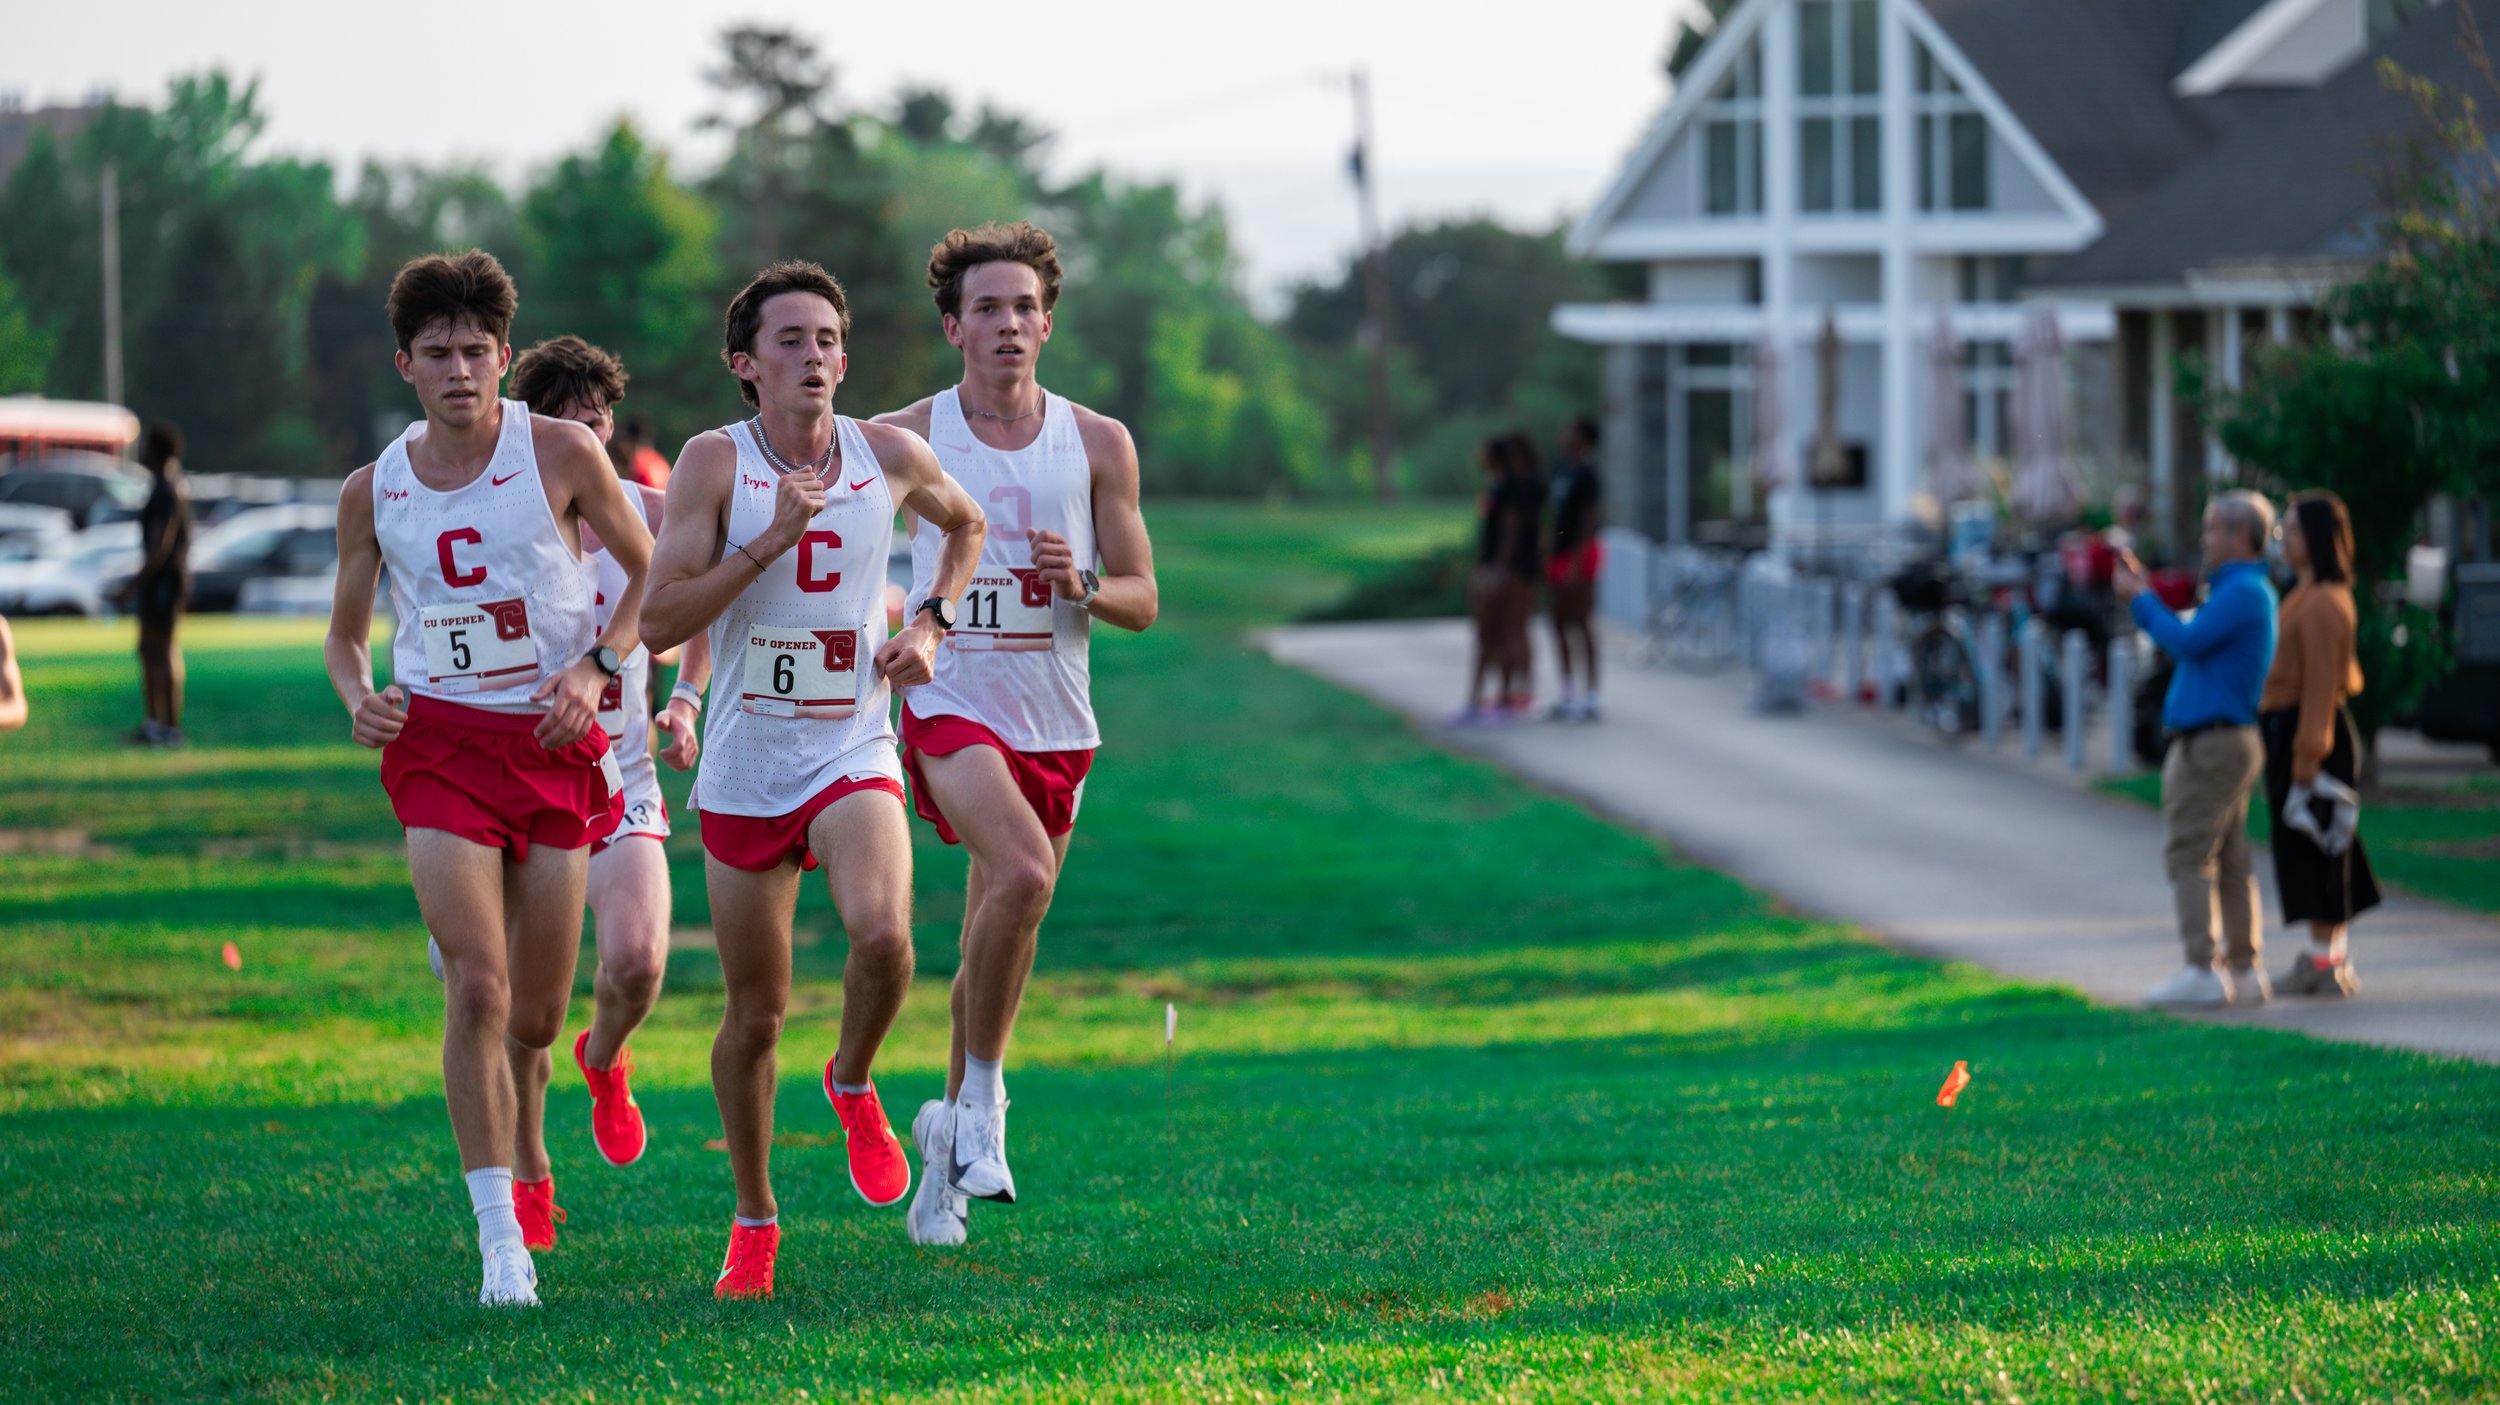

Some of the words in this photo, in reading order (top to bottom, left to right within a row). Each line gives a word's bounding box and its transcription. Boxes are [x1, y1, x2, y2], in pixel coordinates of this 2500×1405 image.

[437, 527, 488, 589] C
[796, 530, 842, 593] C
[424, 619, 437, 628] CU
[441, 614, 486, 626] OPENER
[966, 590, 1001, 629] 11
[450, 630, 471, 670] 5
[751, 637, 766, 647] CU
[770, 640, 817, 650] OPENER
[773, 654, 795, 694] 6
